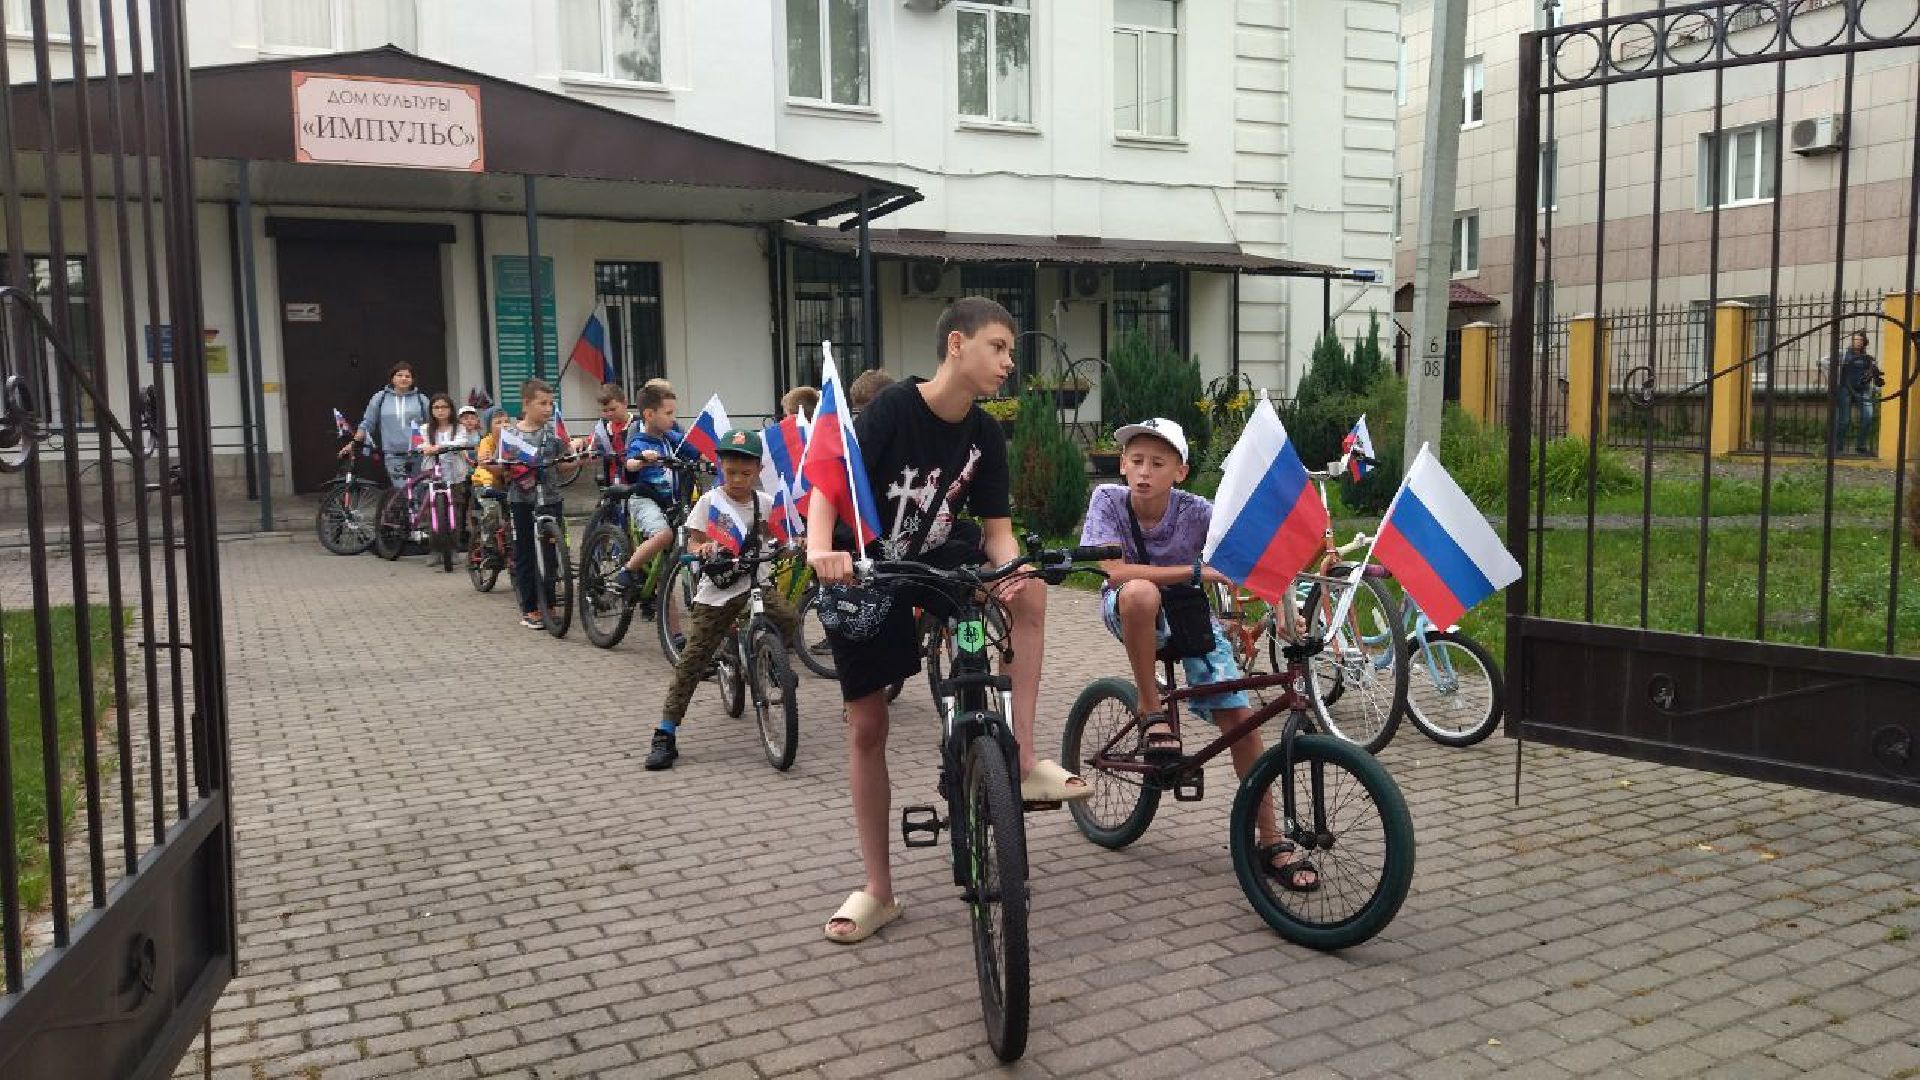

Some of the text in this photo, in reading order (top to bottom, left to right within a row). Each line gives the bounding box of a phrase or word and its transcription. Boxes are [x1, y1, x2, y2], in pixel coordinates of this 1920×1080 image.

[328, 90, 450, 111] ДОМ КУЛЬТУРЫ
[303, 114, 474, 147] «ИМПУЛЬС»
[1424, 360, 1440, 376] 08
